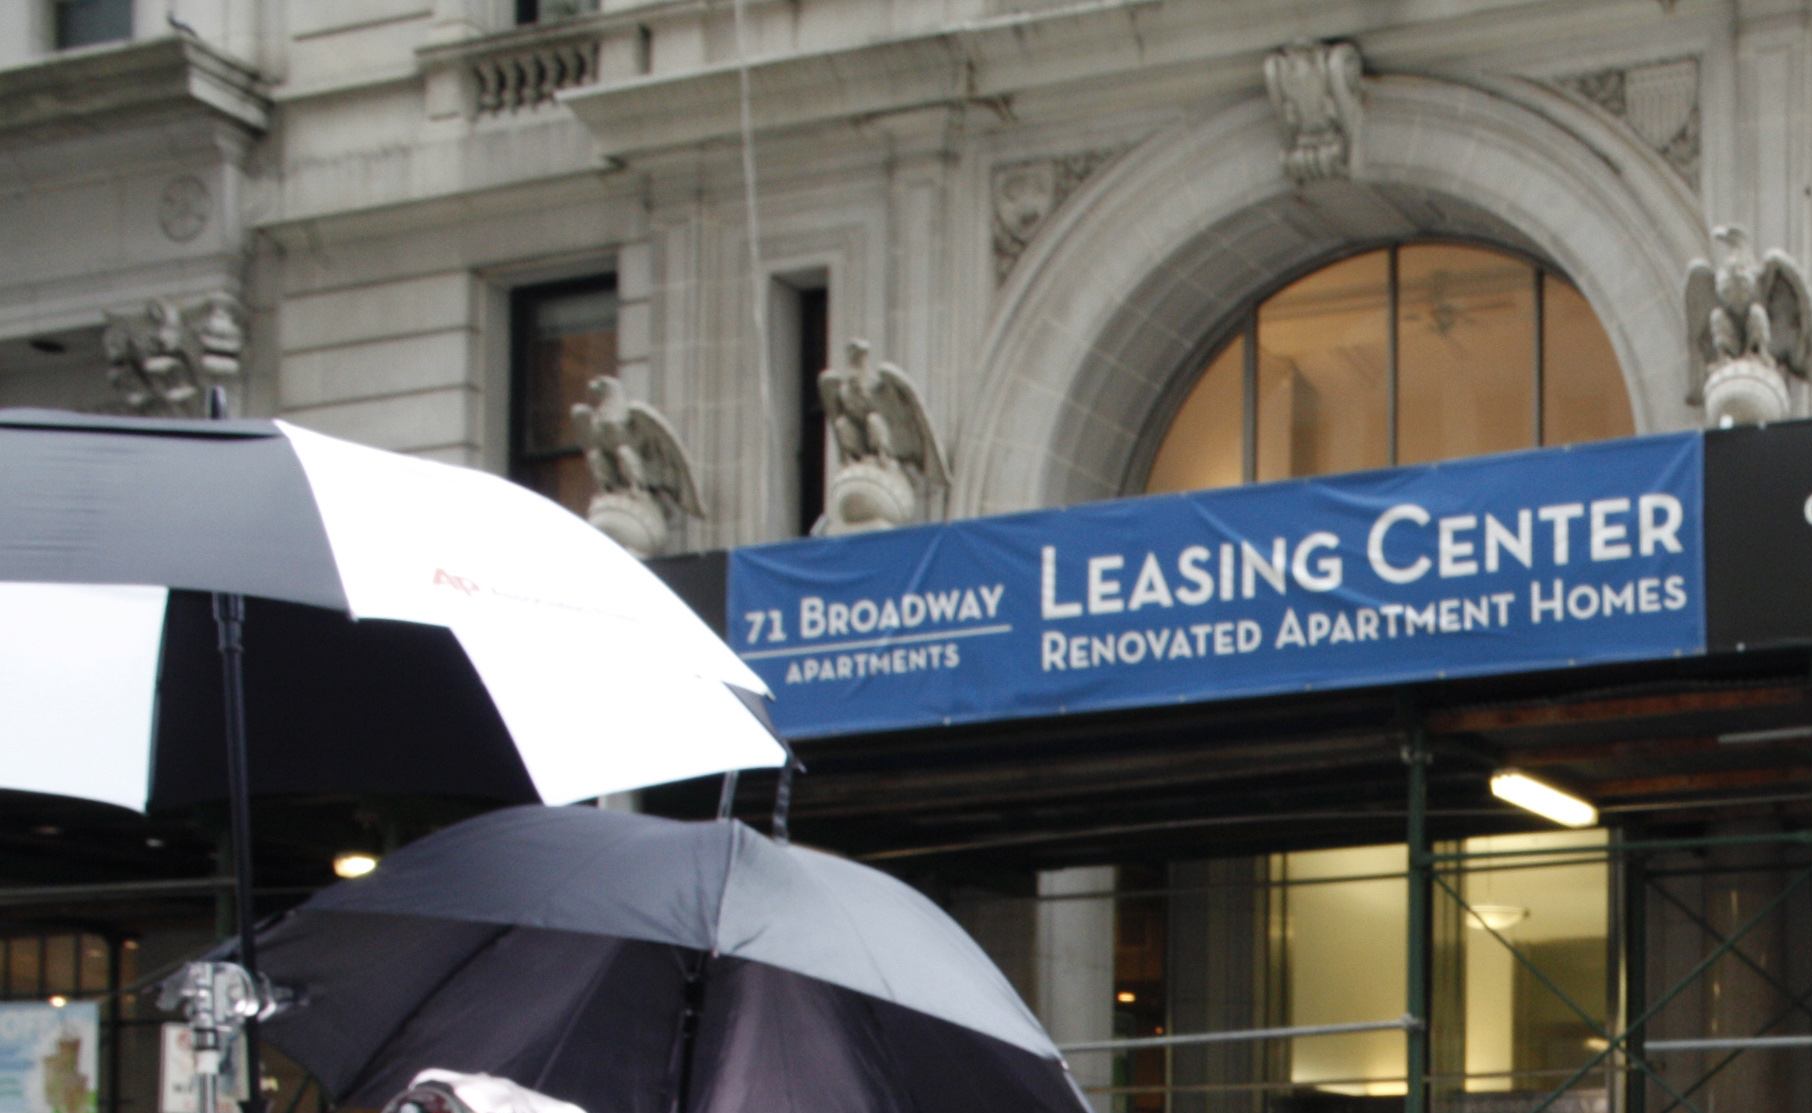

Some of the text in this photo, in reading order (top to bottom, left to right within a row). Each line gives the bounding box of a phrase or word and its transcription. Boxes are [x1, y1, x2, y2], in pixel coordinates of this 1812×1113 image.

[1041, 493, 1685, 620] LEASING CENTER
[745, 583, 1005, 645] 71 BROADWAY
[1041, 575, 1688, 672] RENOVATED APARTMENT HOMES
[785, 643, 960, 684] APARTMENTS
